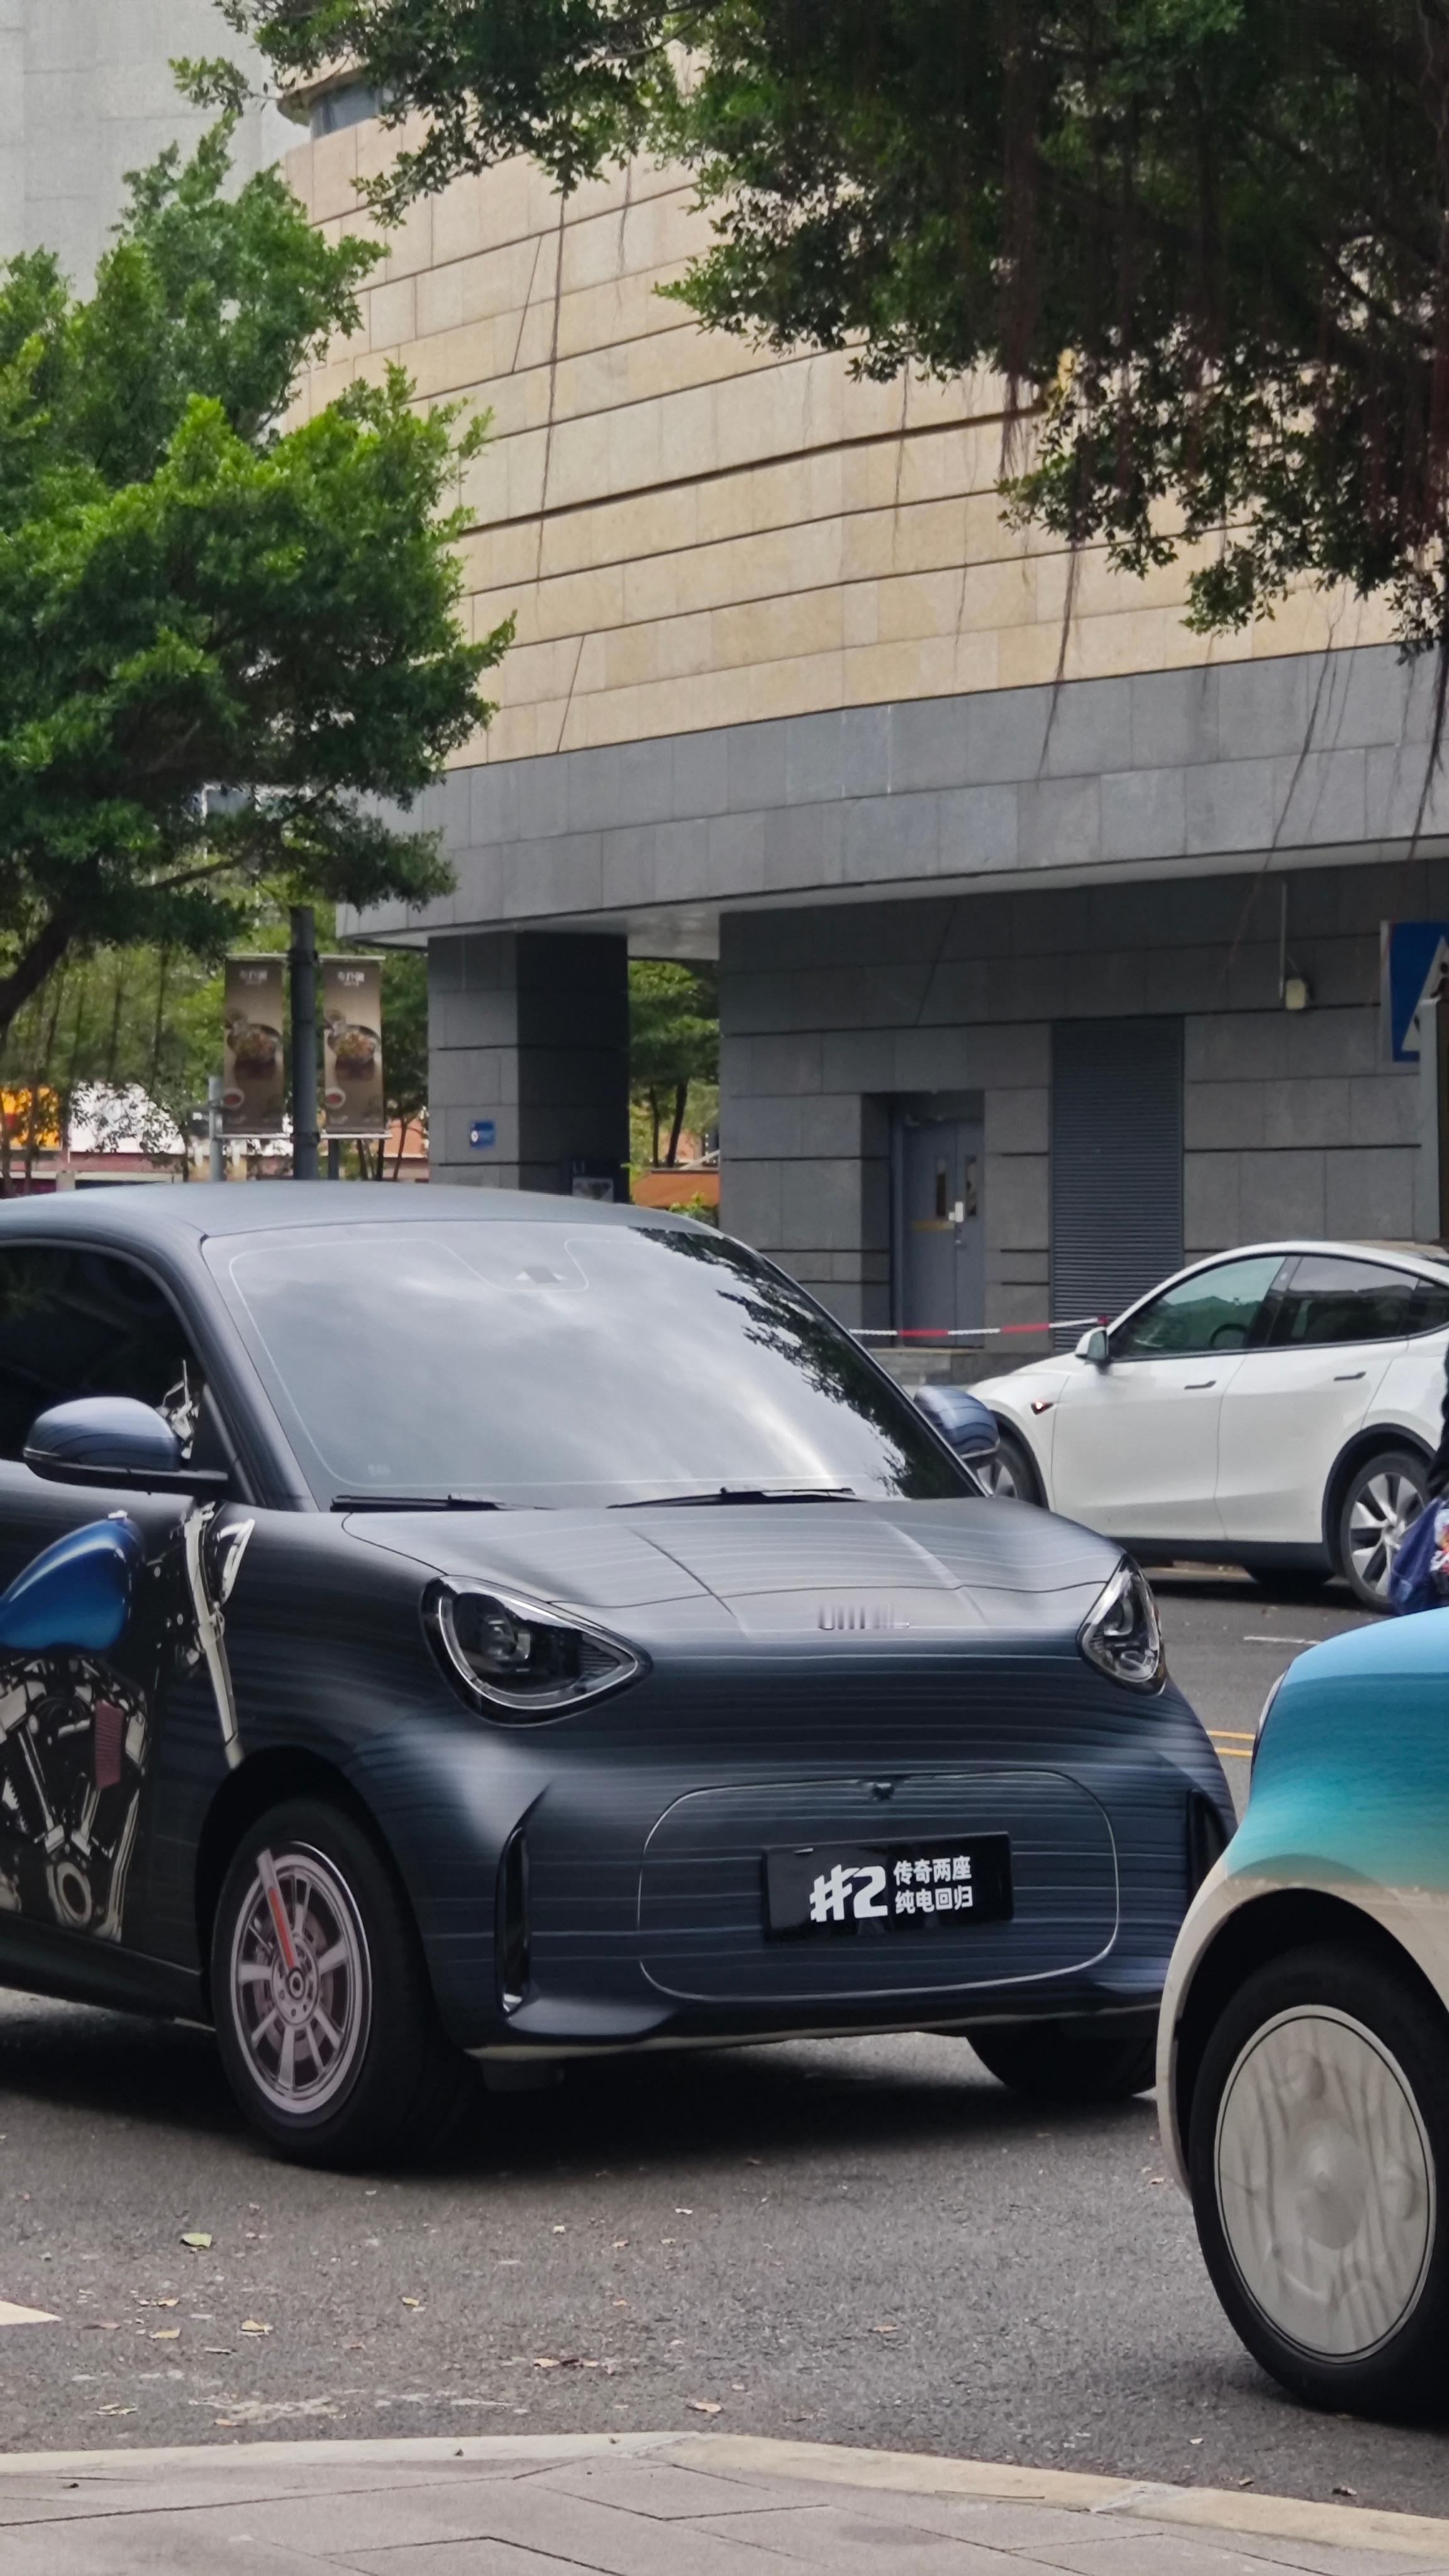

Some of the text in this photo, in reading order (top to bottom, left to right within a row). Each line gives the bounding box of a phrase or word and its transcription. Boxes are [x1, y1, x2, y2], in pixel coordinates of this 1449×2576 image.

[893, 1855, 972, 1886] 传奇两座
[809, 1864, 888, 1923] #2
[895, 1885, 973, 1914] 纯电回归
